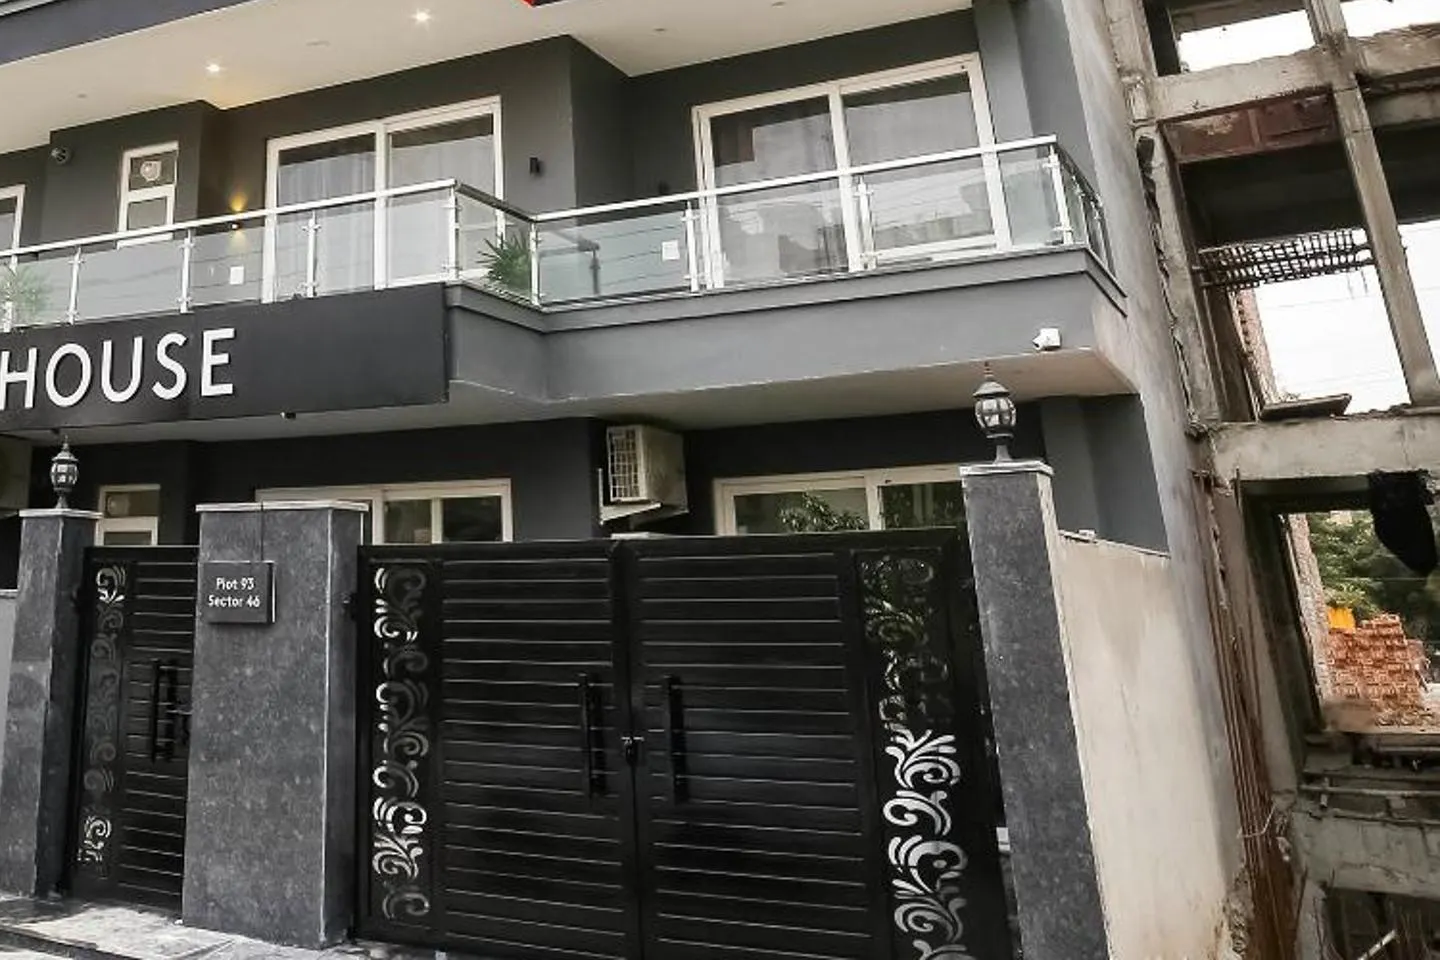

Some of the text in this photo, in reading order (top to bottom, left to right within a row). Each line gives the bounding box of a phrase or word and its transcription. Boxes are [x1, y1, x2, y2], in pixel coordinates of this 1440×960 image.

[215, 577, 255, 590] Plot 93
[208, 594, 260, 608] Sector 46
